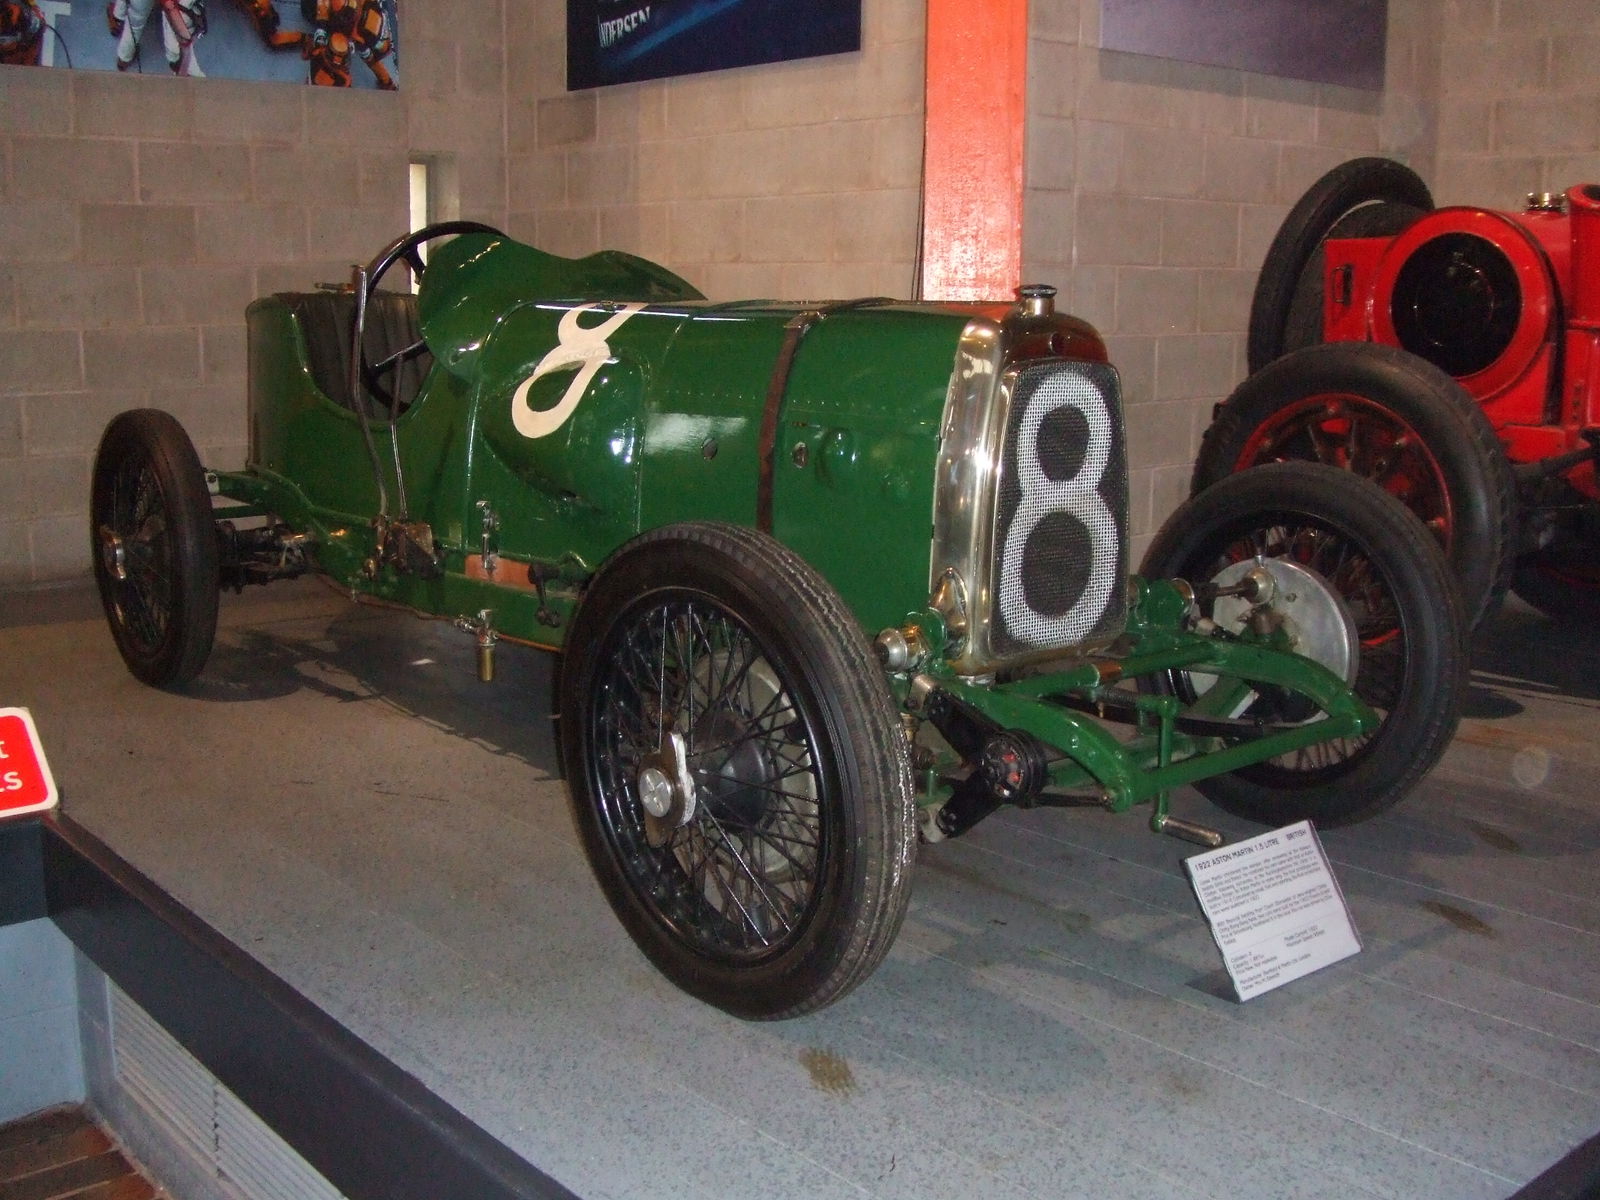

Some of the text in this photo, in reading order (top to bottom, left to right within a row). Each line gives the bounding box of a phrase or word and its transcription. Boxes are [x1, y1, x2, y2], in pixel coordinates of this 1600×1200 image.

[512, 302, 649, 438] 8
[1000, 372, 1119, 647] 8
[1194, 860, 1211, 871] 1922
[1211, 853, 1232, 866] ASTON
[1232, 845, 1254, 858] MARTIN
[1265, 837, 1280, 848] LITRE
[1285, 829, 1307, 840] BRITISH
